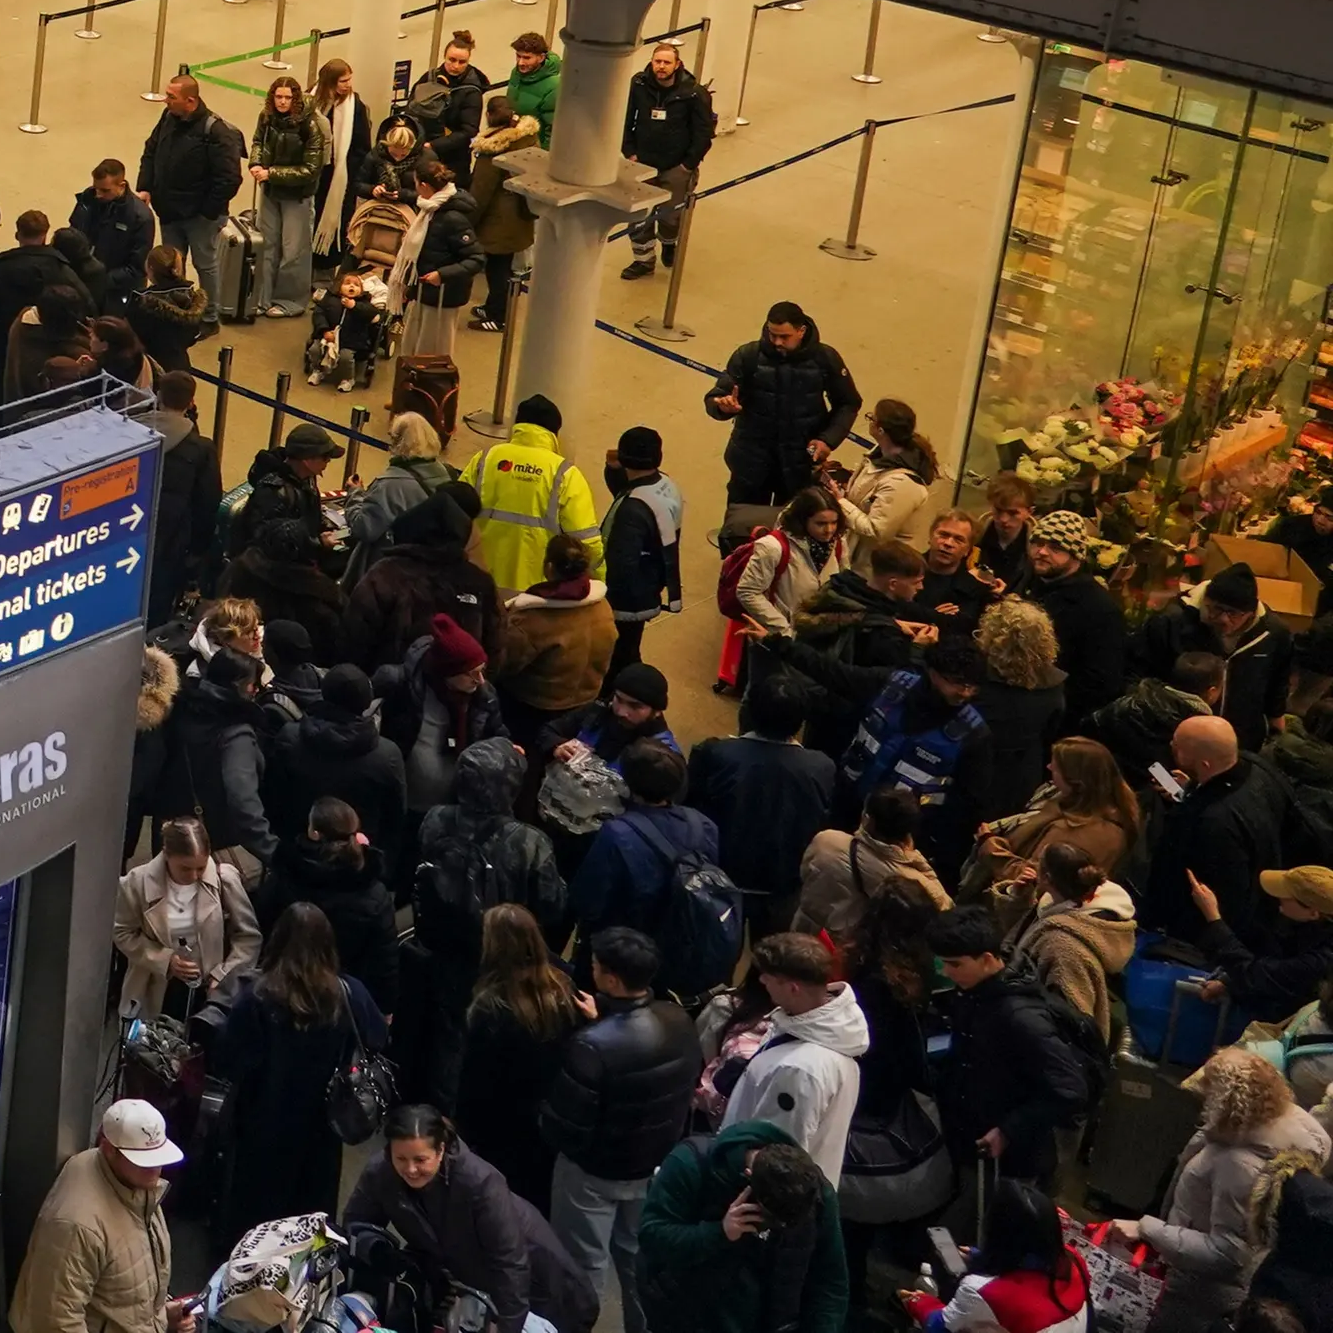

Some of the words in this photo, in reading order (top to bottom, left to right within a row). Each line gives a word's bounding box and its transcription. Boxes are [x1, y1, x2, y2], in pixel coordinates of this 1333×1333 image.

[64, 464, 137, 498] Pre-registration
[513, 462, 544, 476] mitie
[125, 477, 135, 493] A
[36, 564, 107, 606] tickets
